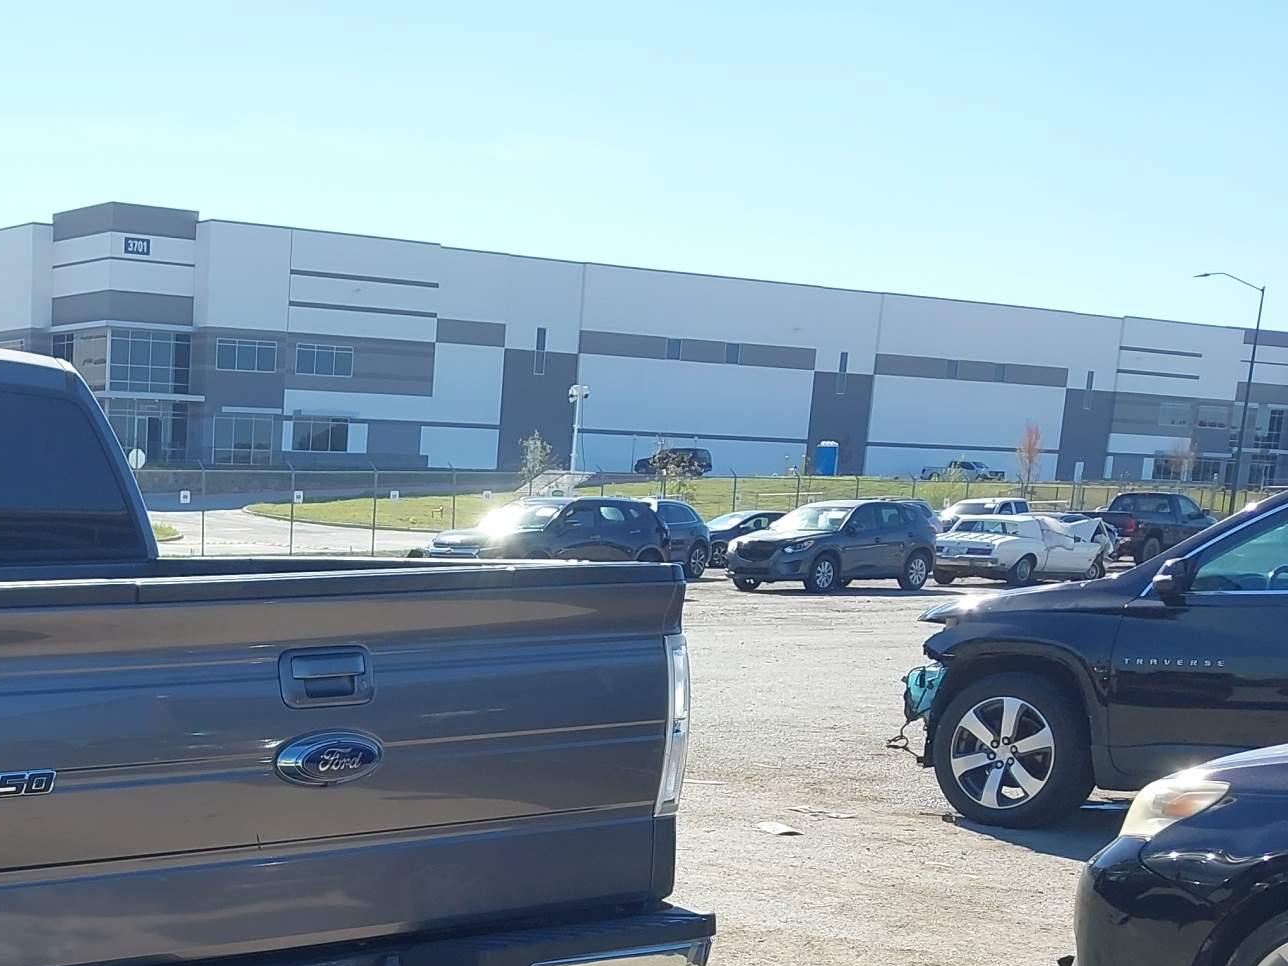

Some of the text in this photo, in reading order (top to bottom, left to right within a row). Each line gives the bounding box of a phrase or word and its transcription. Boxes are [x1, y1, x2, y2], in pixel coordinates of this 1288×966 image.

[127, 240, 147, 253] 3701
[1124, 658, 1225, 667] TRAVERSE
[318, 748, 363, 772] Ford
